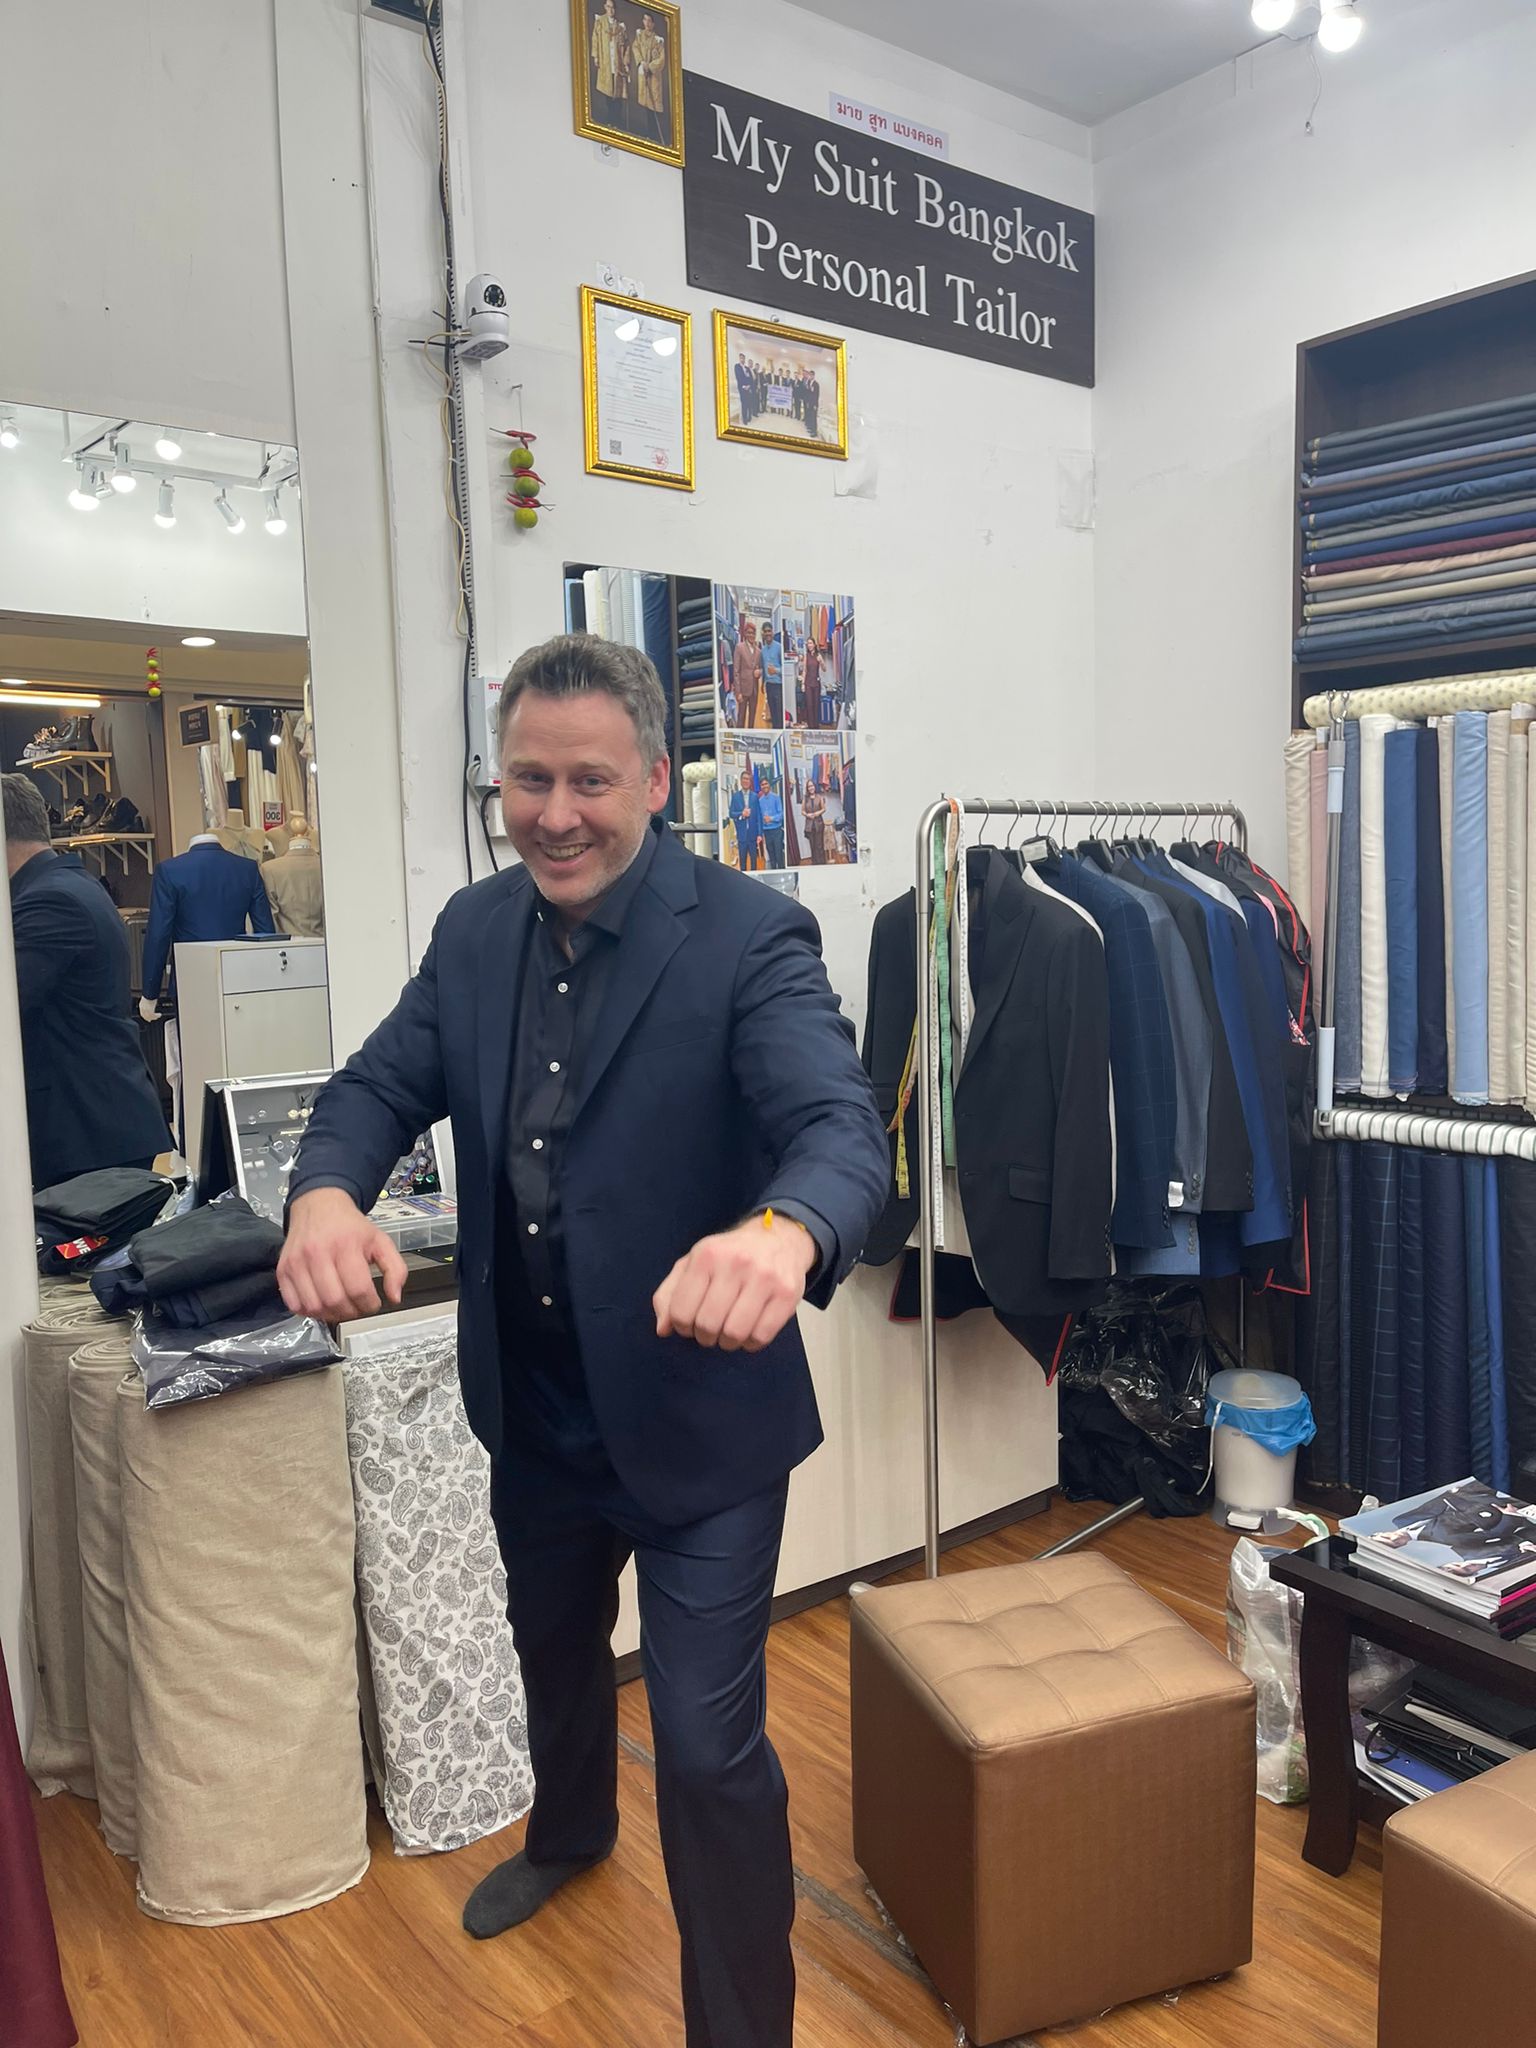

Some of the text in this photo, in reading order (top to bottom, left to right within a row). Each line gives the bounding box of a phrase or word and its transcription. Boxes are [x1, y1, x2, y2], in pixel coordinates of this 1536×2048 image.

[709, 102, 1080, 273] My Suit Bangkok
[869, 113, 888, 133] สูท
[744, 213, 1057, 350] Personal Tailor
